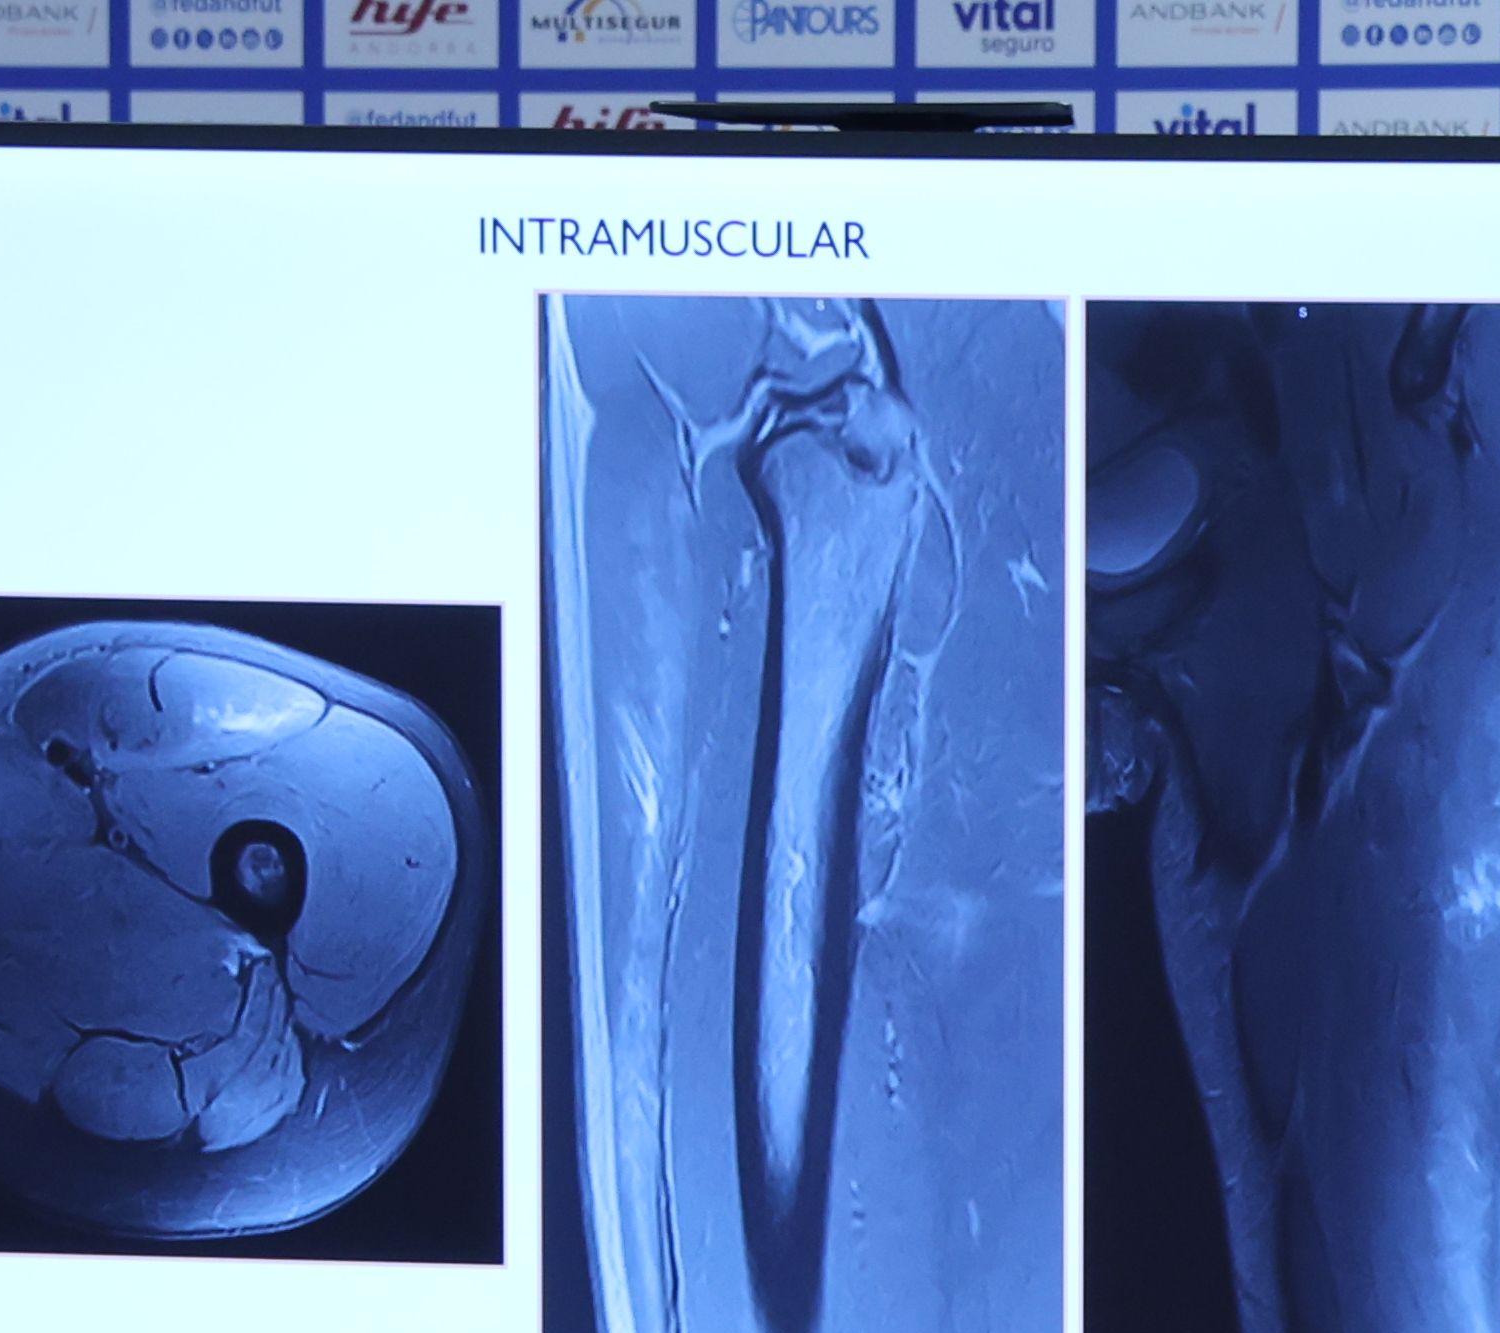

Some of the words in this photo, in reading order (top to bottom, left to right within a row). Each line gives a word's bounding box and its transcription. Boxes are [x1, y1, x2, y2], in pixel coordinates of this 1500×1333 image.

[531, 14, 681, 31] MULTISEGUR
[749, 0, 880, 43] PANTOURS
[1129, 1, 1266, 21] ANDBANK
[981, 34, 1055, 57] seguro
[479, 217, 870, 259] INTRAMUSCULAR
